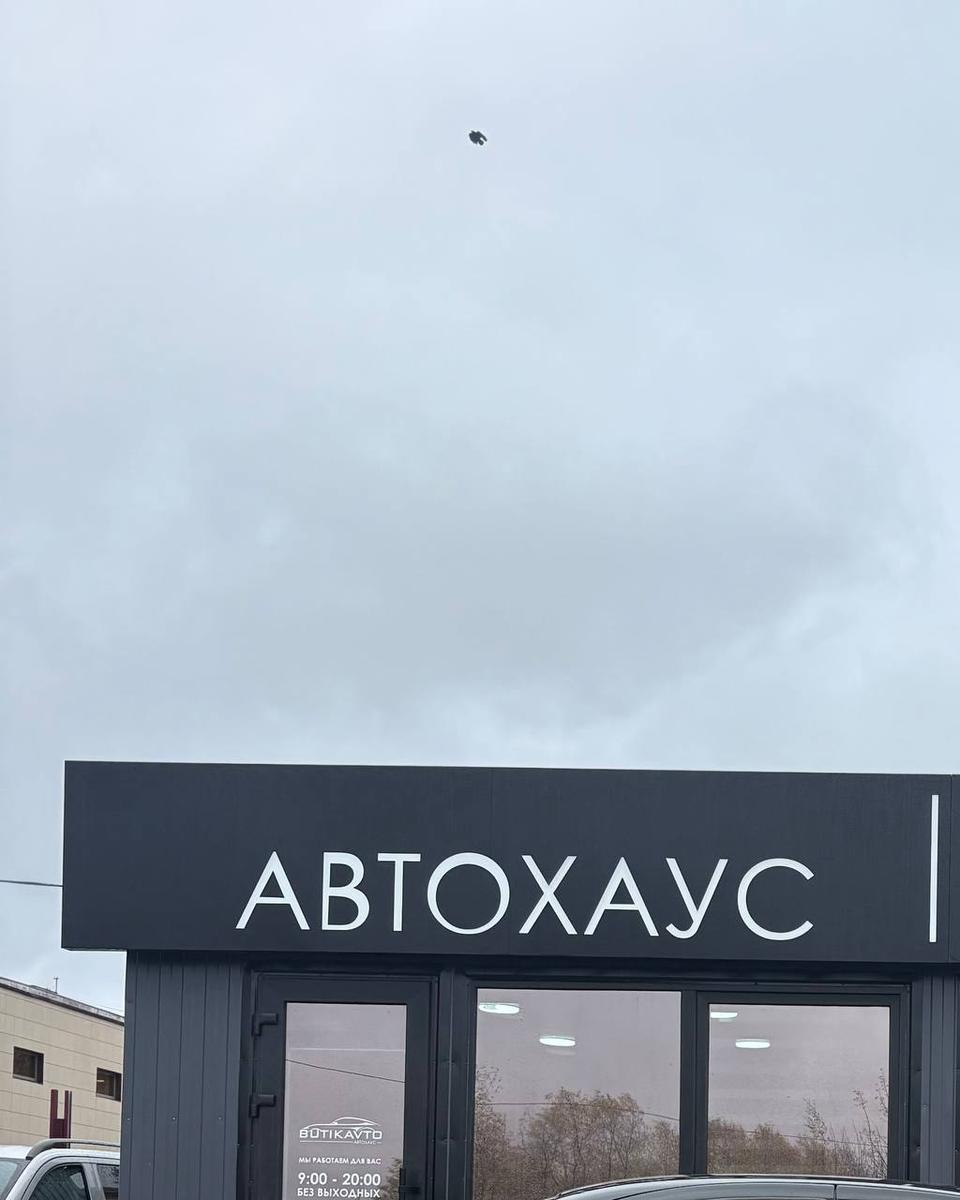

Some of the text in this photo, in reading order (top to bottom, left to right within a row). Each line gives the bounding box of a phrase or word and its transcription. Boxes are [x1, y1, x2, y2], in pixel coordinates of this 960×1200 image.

[236, 851, 814, 941] АВТОХАУС
[299, 1129, 383, 1140] BUTIKAVTO
[298, 1156, 311, 1164] МЫ
[298, 1172, 327, 1185] 9:00
[342, 1173, 381, 1186] 20:00
[297, 1188, 381, 1198] БЕЗ ВЫХОДНЫХ
